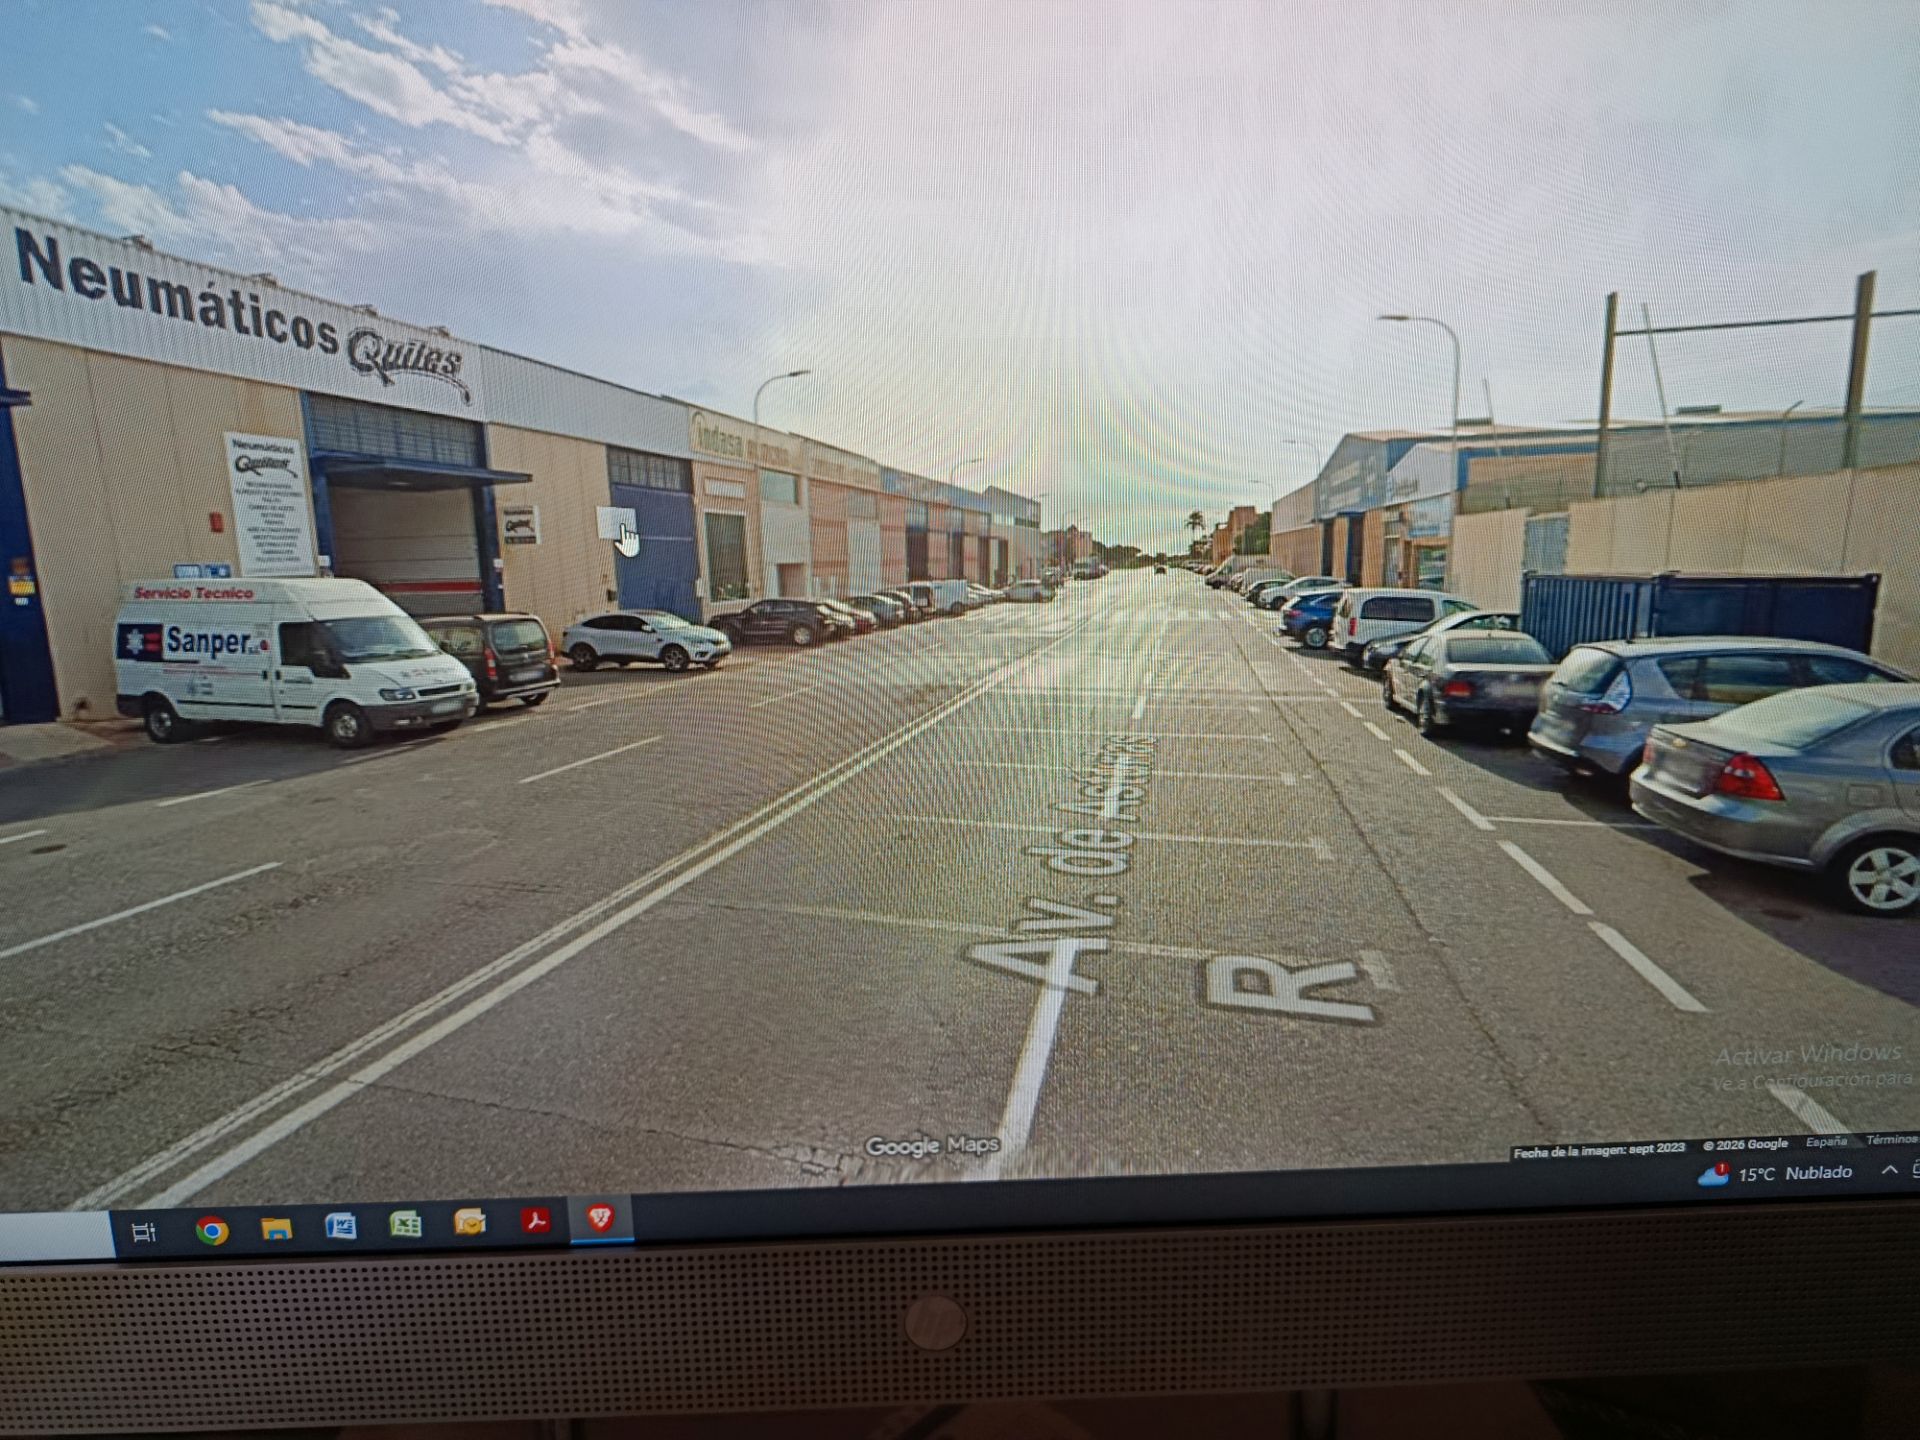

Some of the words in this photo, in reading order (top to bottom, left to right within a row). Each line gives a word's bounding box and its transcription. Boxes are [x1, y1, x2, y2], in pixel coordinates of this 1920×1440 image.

[14, 226, 339, 356] Neumáticos
[134, 587, 191, 600] Servicio
[196, 587, 254, 599] Tecnico
[167, 626, 251, 660] Sanper
[1024, 828, 1136, 875] de
[961, 895, 1120, 996] Av.
[1715, 1048, 1794, 1066] Activar
[1801, 1043, 1902, 1063] Windows
[1876, 1072, 1913, 1088] para
[866, 1136, 940, 1159] Google
[947, 1136, 1000, 1156] Maps
[1717, 1140, 1745, 1150] 2026
[1748, 1138, 1789, 1151] Google
[1806, 1137, 1848, 1149] España
[1866, 1134, 1919, 1145] Términos
[1514, 1147, 1548, 1159] Fecha
[1551, 1147, 1566, 1157] de
[1568, 1146, 1579, 1157] la
[1582, 1146, 1627, 1158] imagen:
[1629, 1146, 1654, 1155] sept
[1656, 1142, 1685, 1153] 2023
[1739, 1167, 1776, 1181] 15°C
[1786, 1165, 1853, 1180] Nublado
